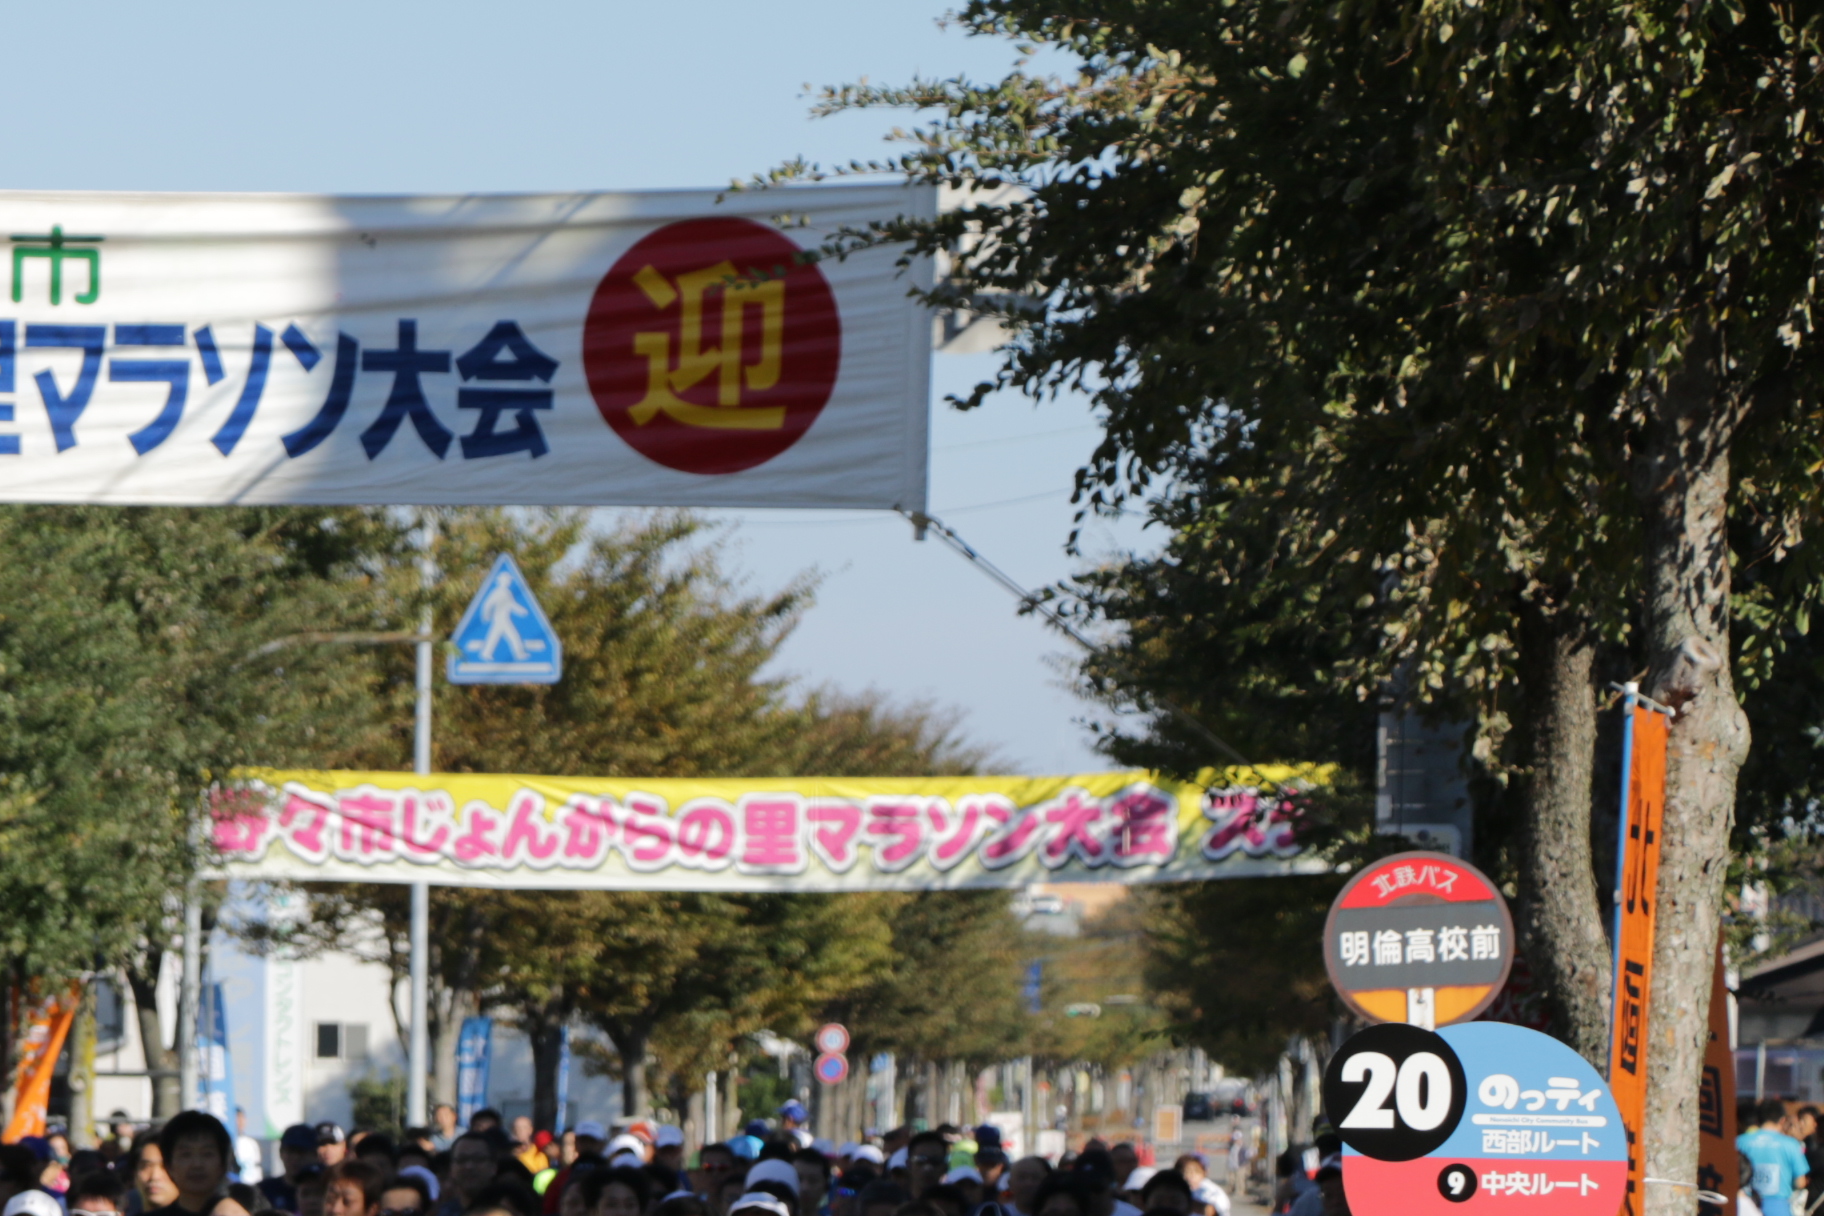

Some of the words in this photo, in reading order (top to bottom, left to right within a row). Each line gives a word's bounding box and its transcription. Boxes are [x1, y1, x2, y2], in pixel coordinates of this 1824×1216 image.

[628, 261, 786, 429] 迎
[1371, 865, 1458, 898] 北鉄バス
[1340, 924, 1500, 966] 明倫高校前
[1339, 1051, 1451, 1131] 20
[1478, 1074, 1601, 1111] のっティ
[1482, 1130, 1600, 1155] 西部ルート
[1448, 1172, 1466, 1194] 9
[1482, 1171, 1599, 1196] 中央ルート
